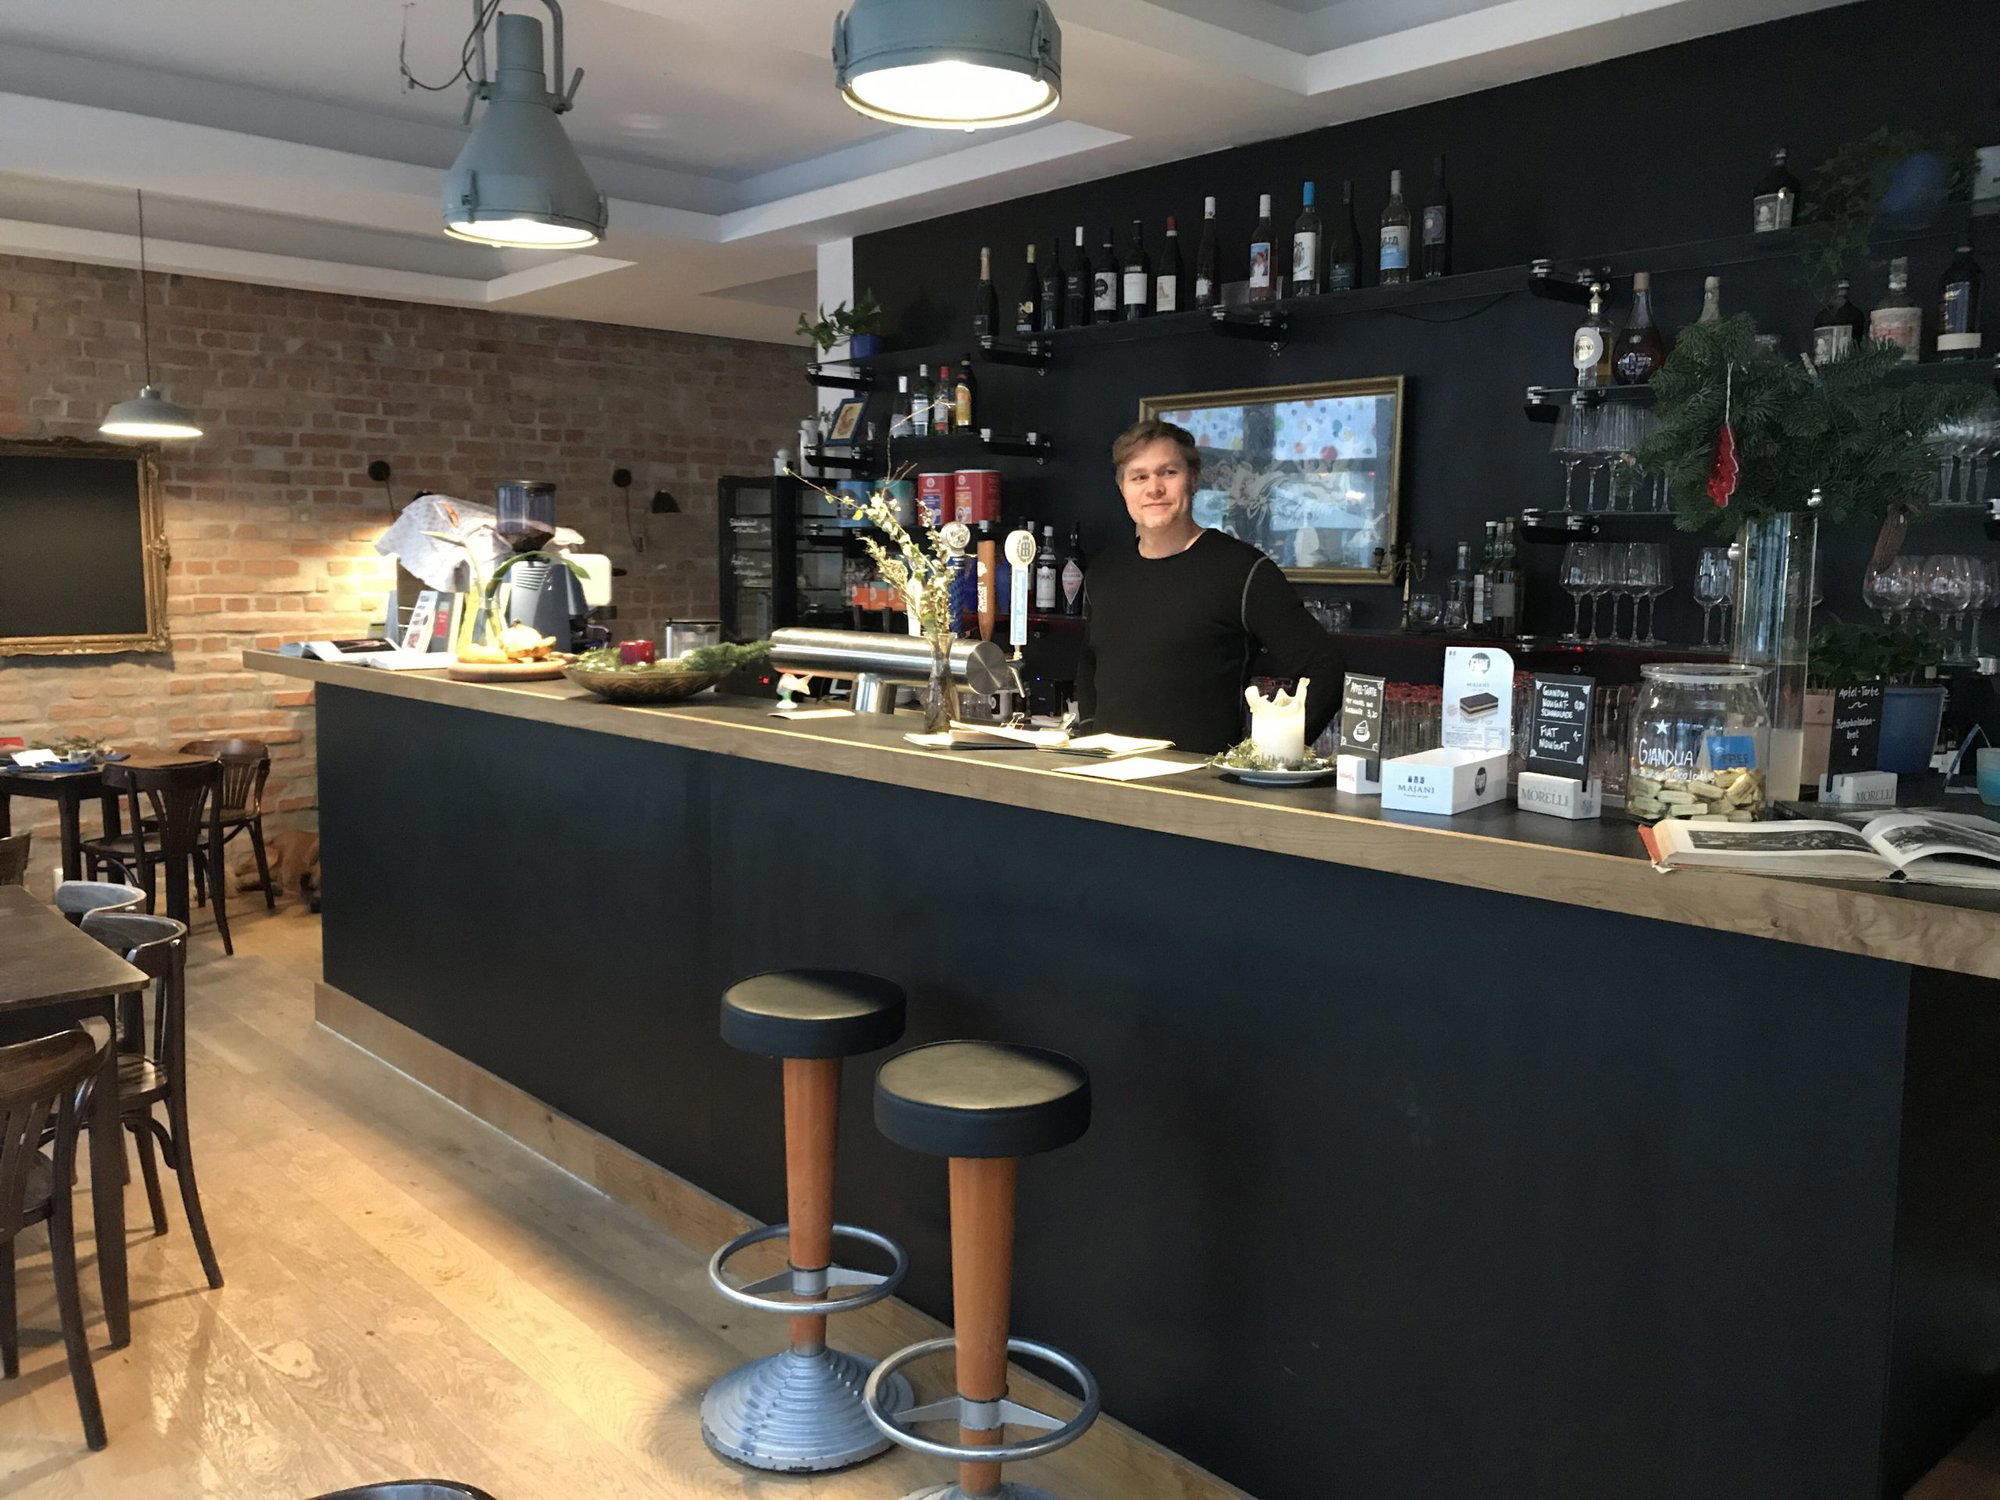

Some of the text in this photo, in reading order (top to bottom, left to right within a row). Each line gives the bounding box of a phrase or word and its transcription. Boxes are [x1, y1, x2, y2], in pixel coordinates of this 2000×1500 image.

[1540, 724, 1559, 738] FIAT
[1539, 738, 1570, 752] NOUGAT
[1639, 738, 1694, 767] GIANDUA
[1520, 788, 1569, 807] MORELLI
